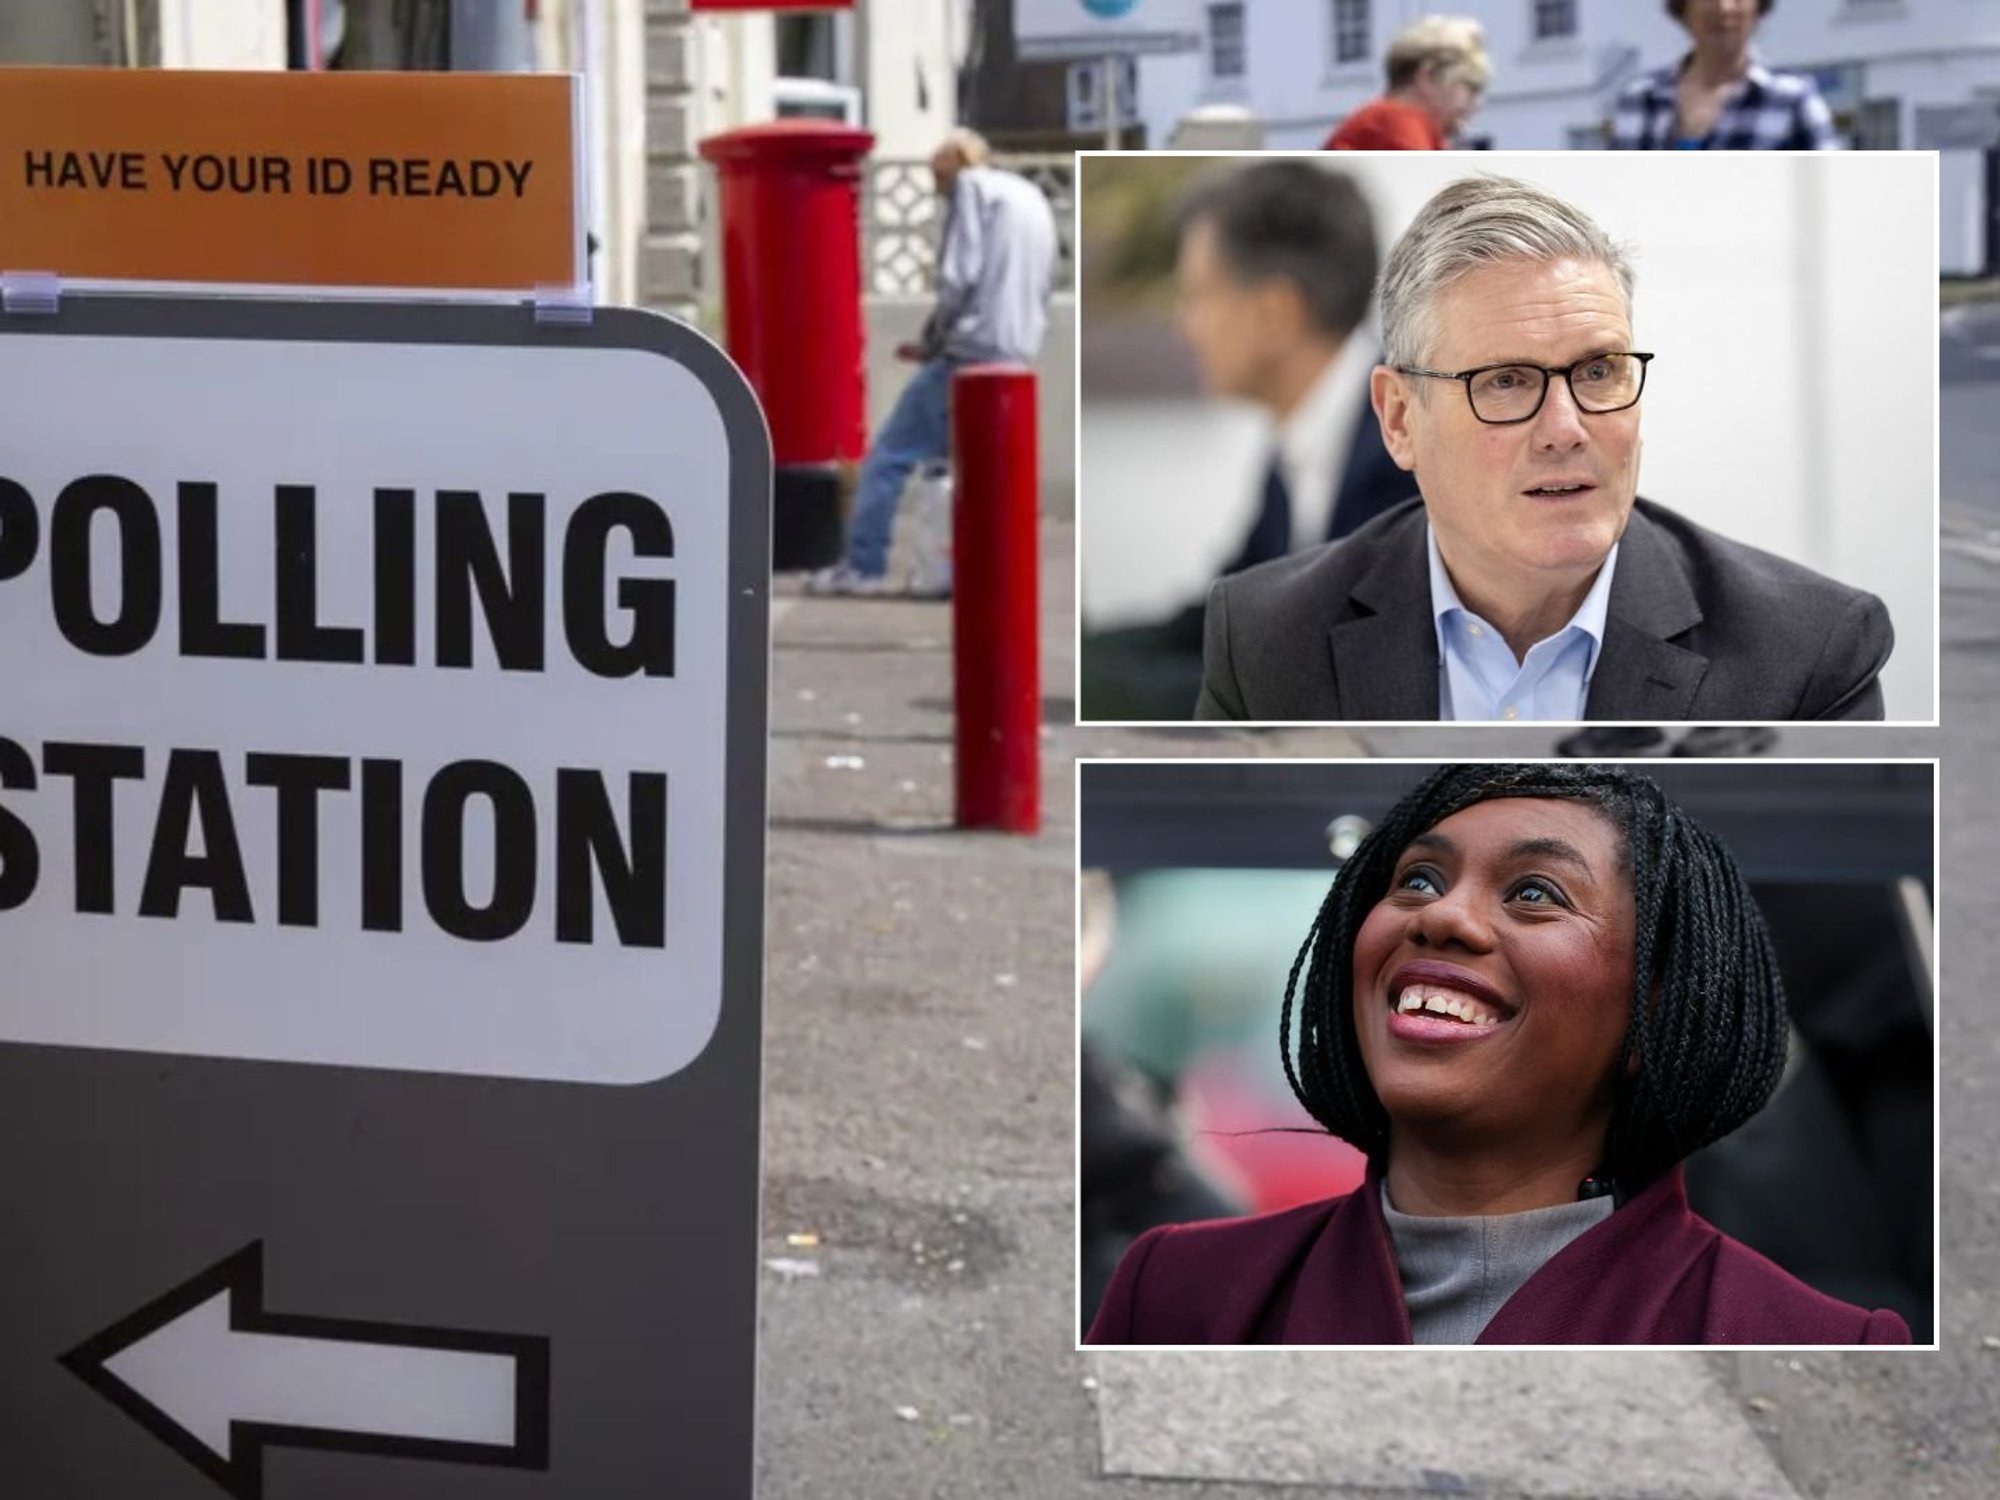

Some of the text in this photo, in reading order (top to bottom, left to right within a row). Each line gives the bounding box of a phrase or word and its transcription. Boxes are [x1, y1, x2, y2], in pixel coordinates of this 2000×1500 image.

[25, 150, 534, 198] HAVE YOUR ID READY
